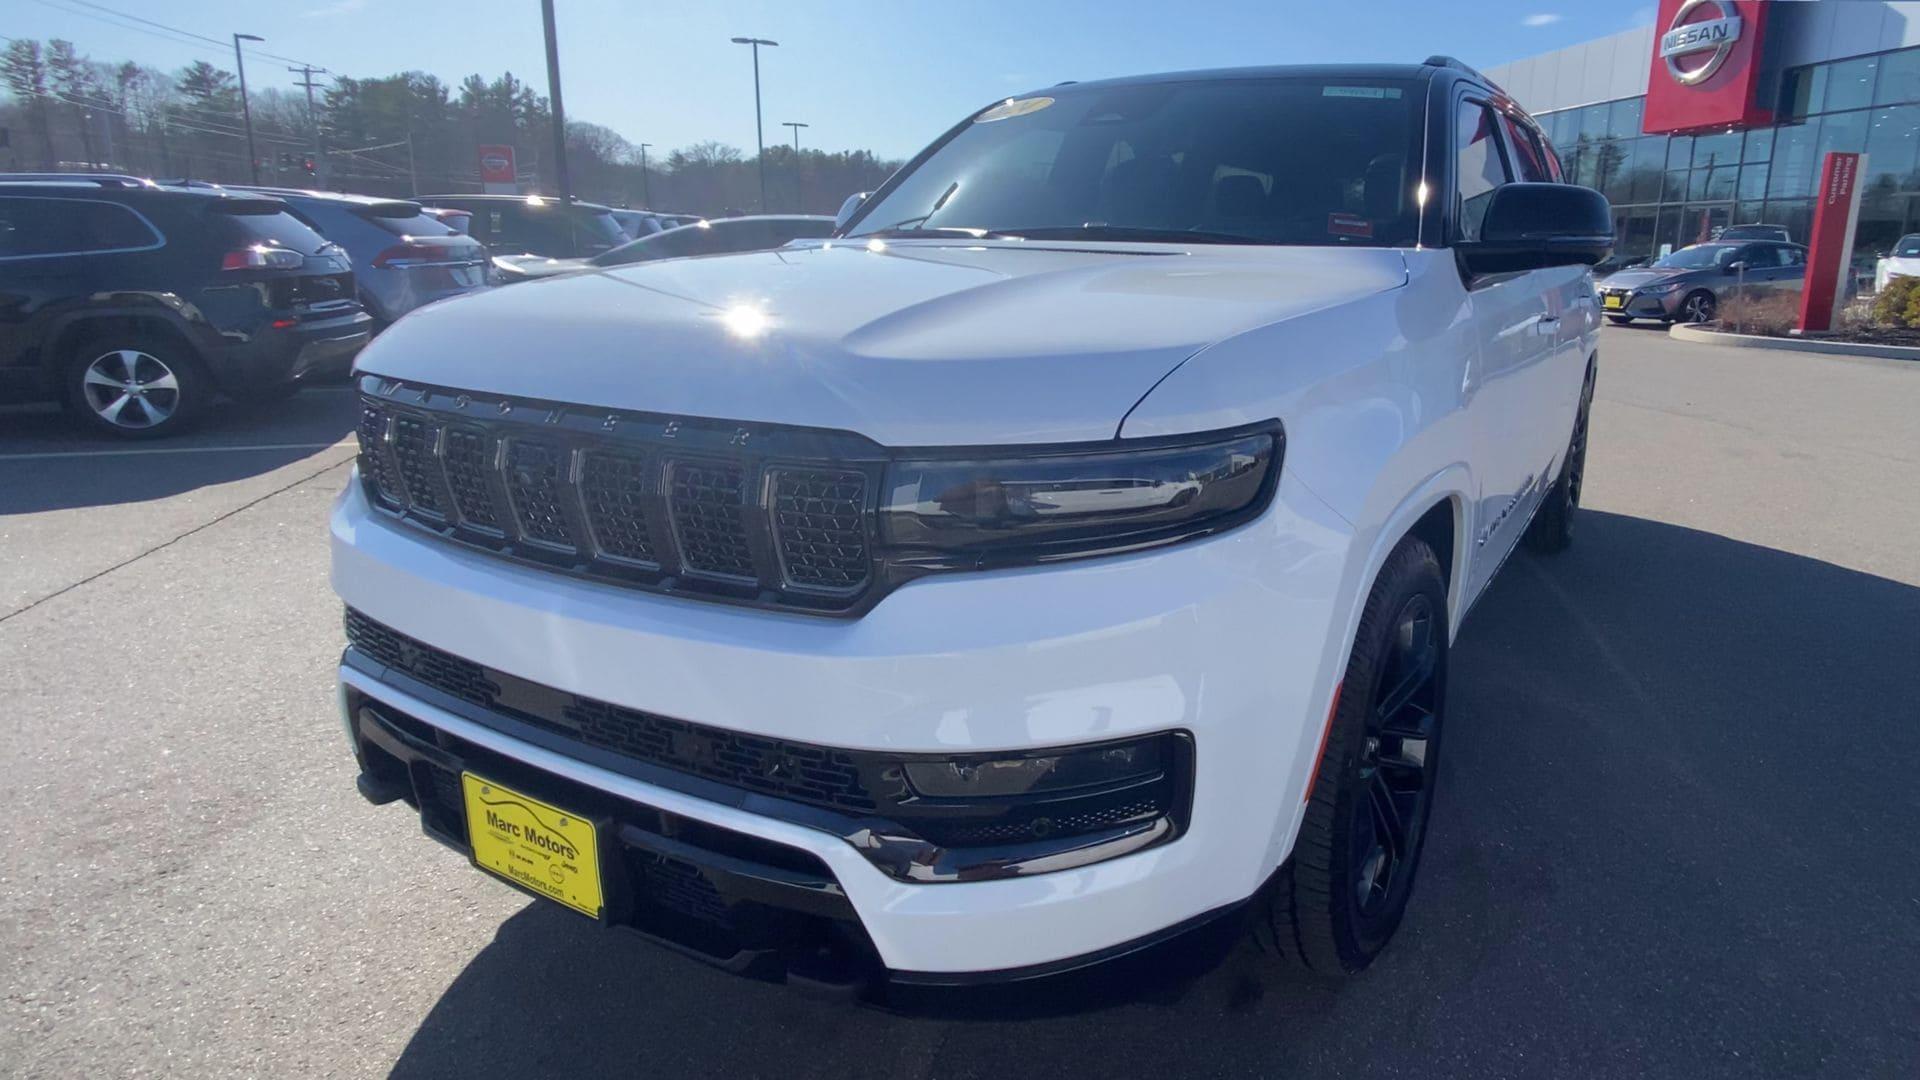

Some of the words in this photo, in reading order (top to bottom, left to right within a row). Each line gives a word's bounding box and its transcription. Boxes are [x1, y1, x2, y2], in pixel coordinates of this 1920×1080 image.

[1664, 23, 1728, 51] NISSAN
[1829, 157, 1842, 205] Customer
[1840, 157, 1853, 195] Parking
[486, 809, 521, 838] Marc
[524, 825, 575, 860] Motors
[507, 864, 565, 898] MarcMotors.com
